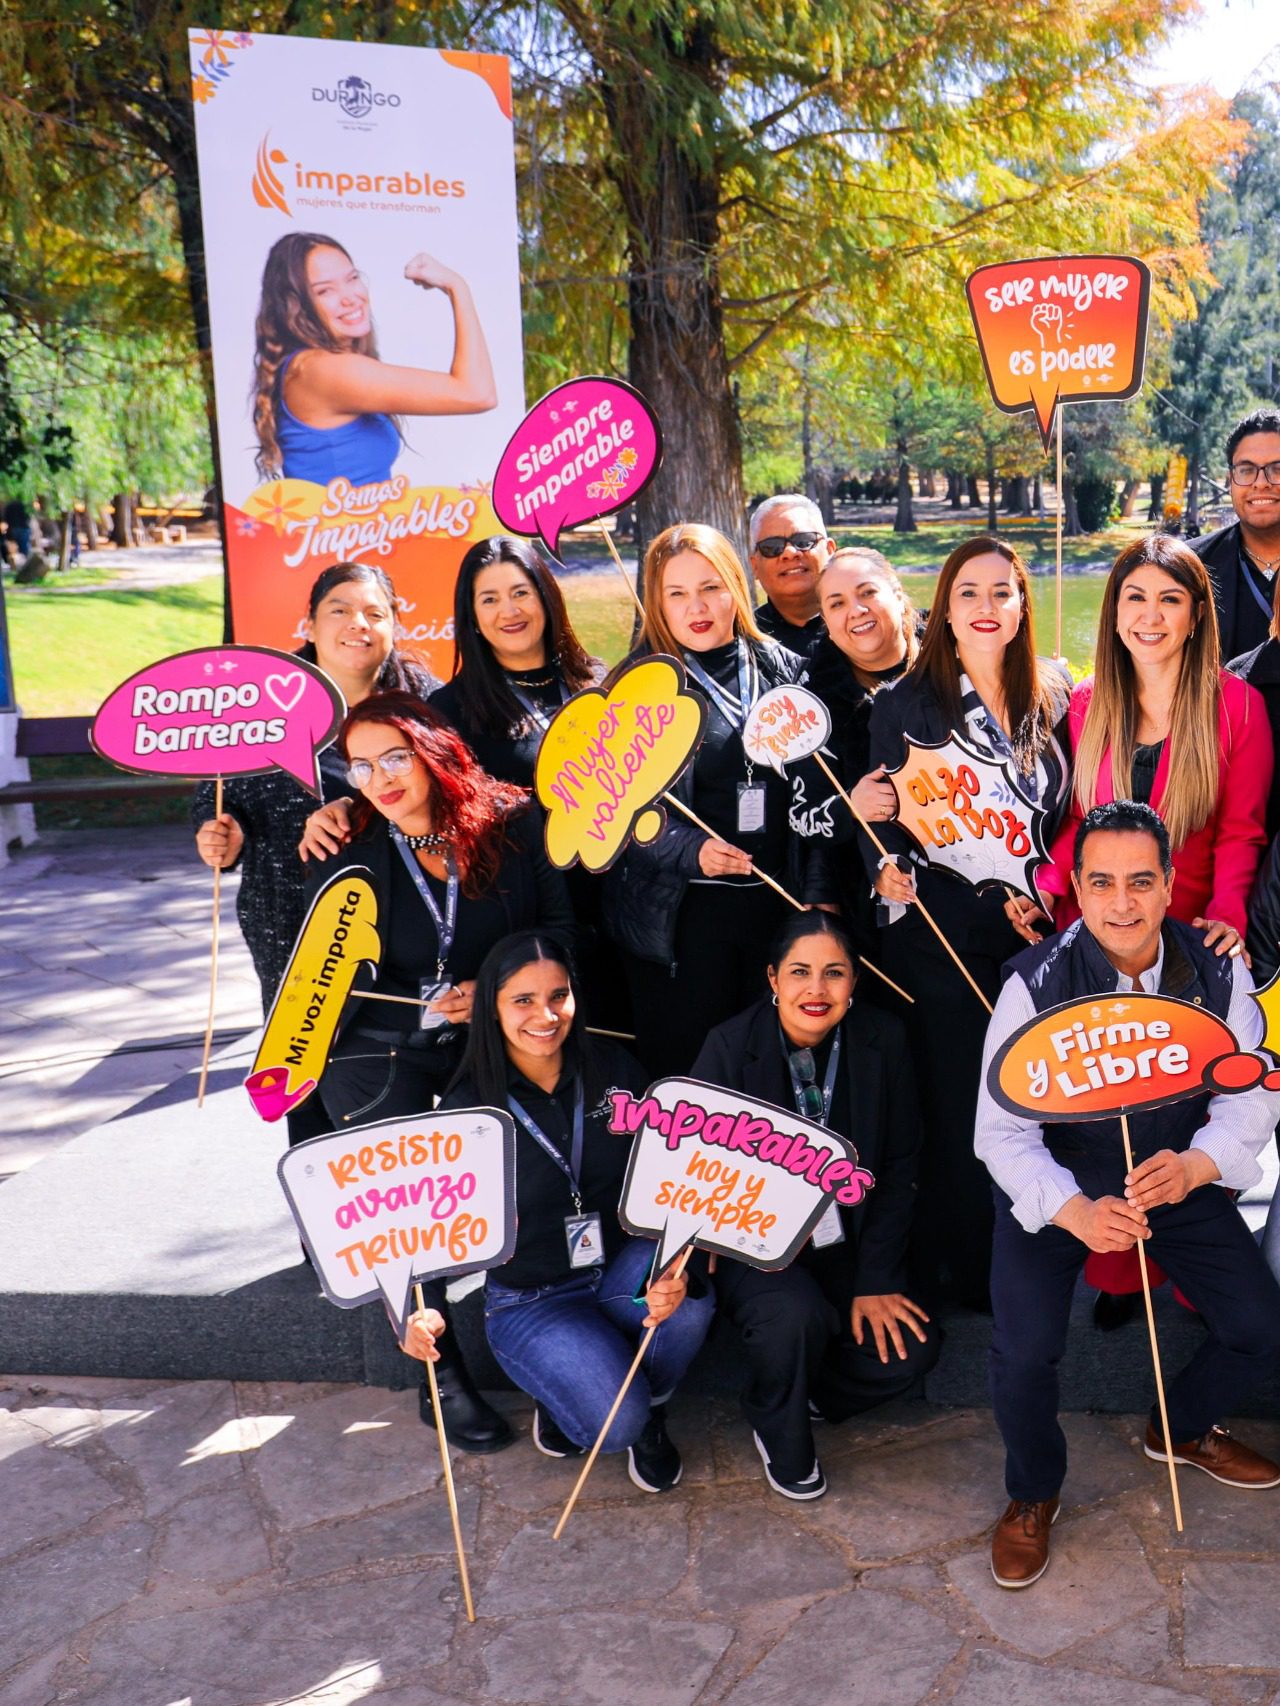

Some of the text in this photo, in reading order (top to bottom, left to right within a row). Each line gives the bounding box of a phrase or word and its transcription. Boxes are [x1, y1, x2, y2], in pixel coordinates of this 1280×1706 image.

[296, 163, 466, 198] imparables
[296, 197, 441, 214] mujeres que transforman
[514, 416, 635, 521] imparable
[516, 397, 613, 483] Siempre
[322, 476, 407, 516] Somos
[283, 498, 476, 567] Imparables
[131, 682, 260, 718] Rompo
[134, 718, 287, 756] barreras
[550, 700, 627, 814] Mujer
[586, 704, 675, 841] valiente
[285, 890, 361, 1065] Mi voz importa
[1050, 1020, 1171, 1063] Firme
[1026, 1043, 1189, 1098] y Libre
[335, 1172, 476, 1229] avanzo
[685, 1150, 766, 1210] hoy y
